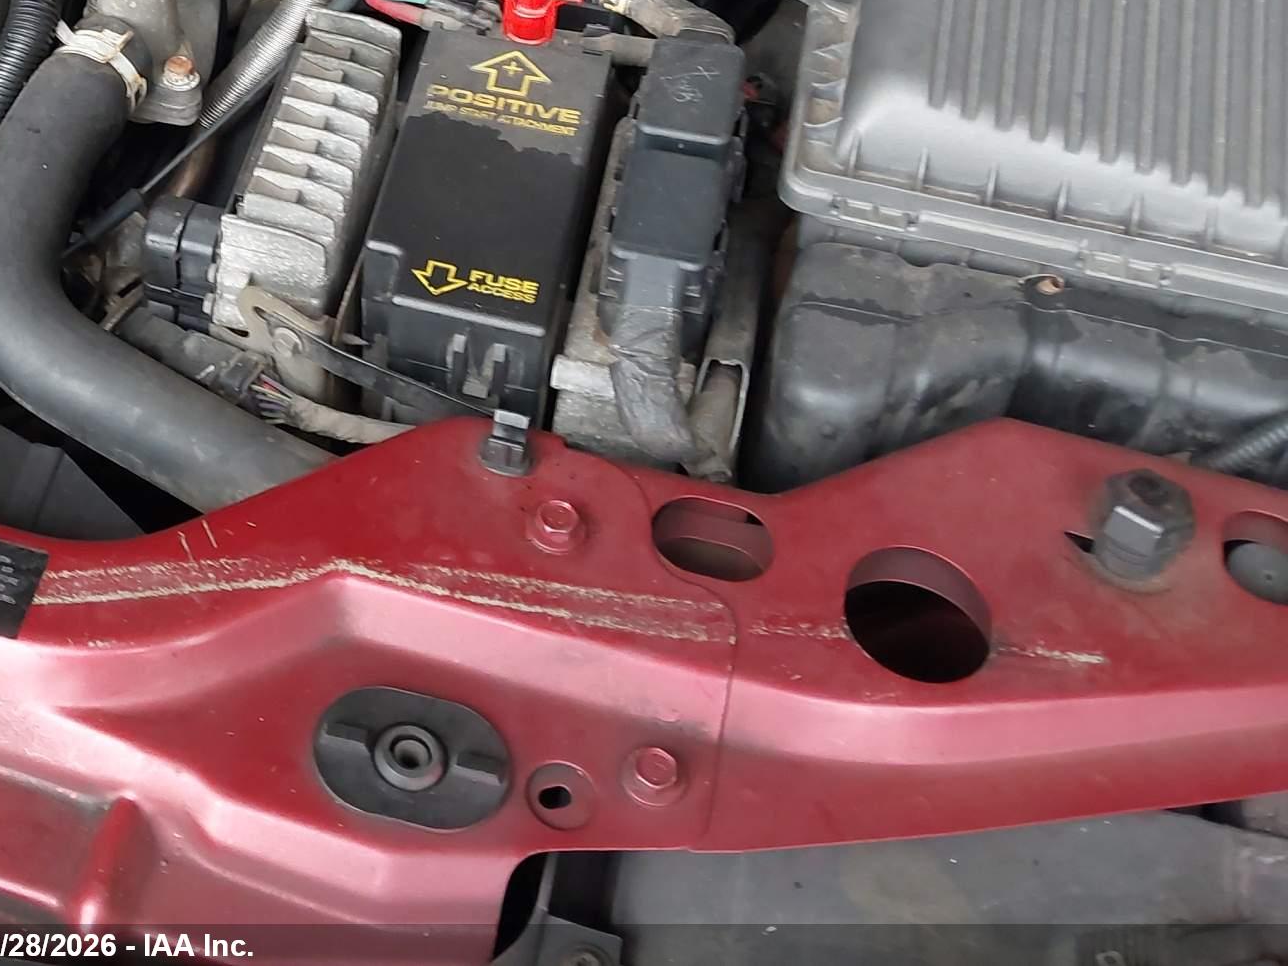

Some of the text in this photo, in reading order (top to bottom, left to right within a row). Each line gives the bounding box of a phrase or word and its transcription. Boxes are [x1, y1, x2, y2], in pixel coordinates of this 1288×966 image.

[426, 84, 582, 125] POSITIVE
[467, 283, 537, 304] ACCESS
[469, 269, 540, 295] FUSE
